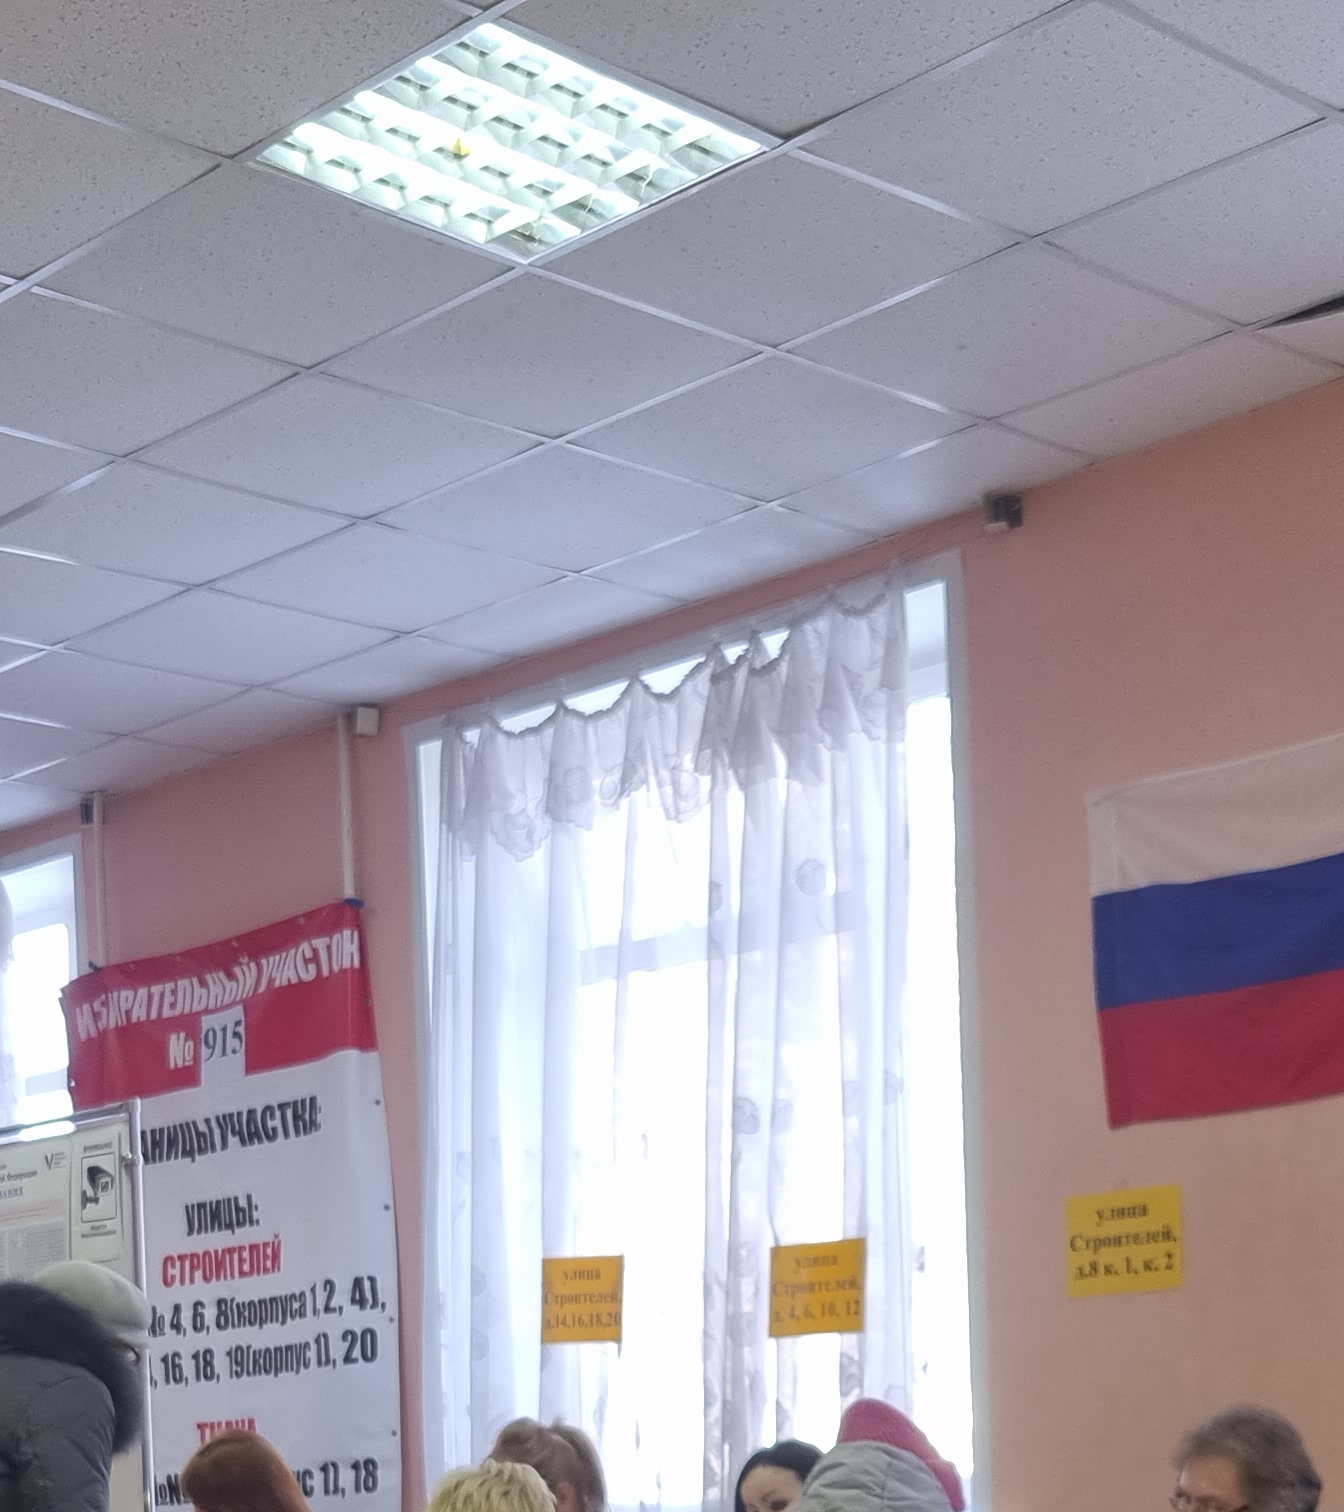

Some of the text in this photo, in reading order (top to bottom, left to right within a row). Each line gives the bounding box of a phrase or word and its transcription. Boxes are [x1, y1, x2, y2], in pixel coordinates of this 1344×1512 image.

[203, 1020, 244, 1062] 915
[184, 1193, 260, 1237] УЛИЦЫ:
[1096, 1205, 1148, 1228] улица
[162, 1232, 282, 1288] СТРОИТЕЛЕЙ
[1070, 1225, 1177, 1255] Строителей,
[1164, 1253, 1173, 1271] 2
[170, 1303, 187, 1338] 4,
[192, 1300, 210, 1335] 6,
[323, 1278, 344, 1317] 2,
[161, 1351, 188, 1386] 16,
[192, 1348, 220, 1384] 18,
[342, 1327, 378, 1365] 20
[350, 1457, 378, 1494] 18
